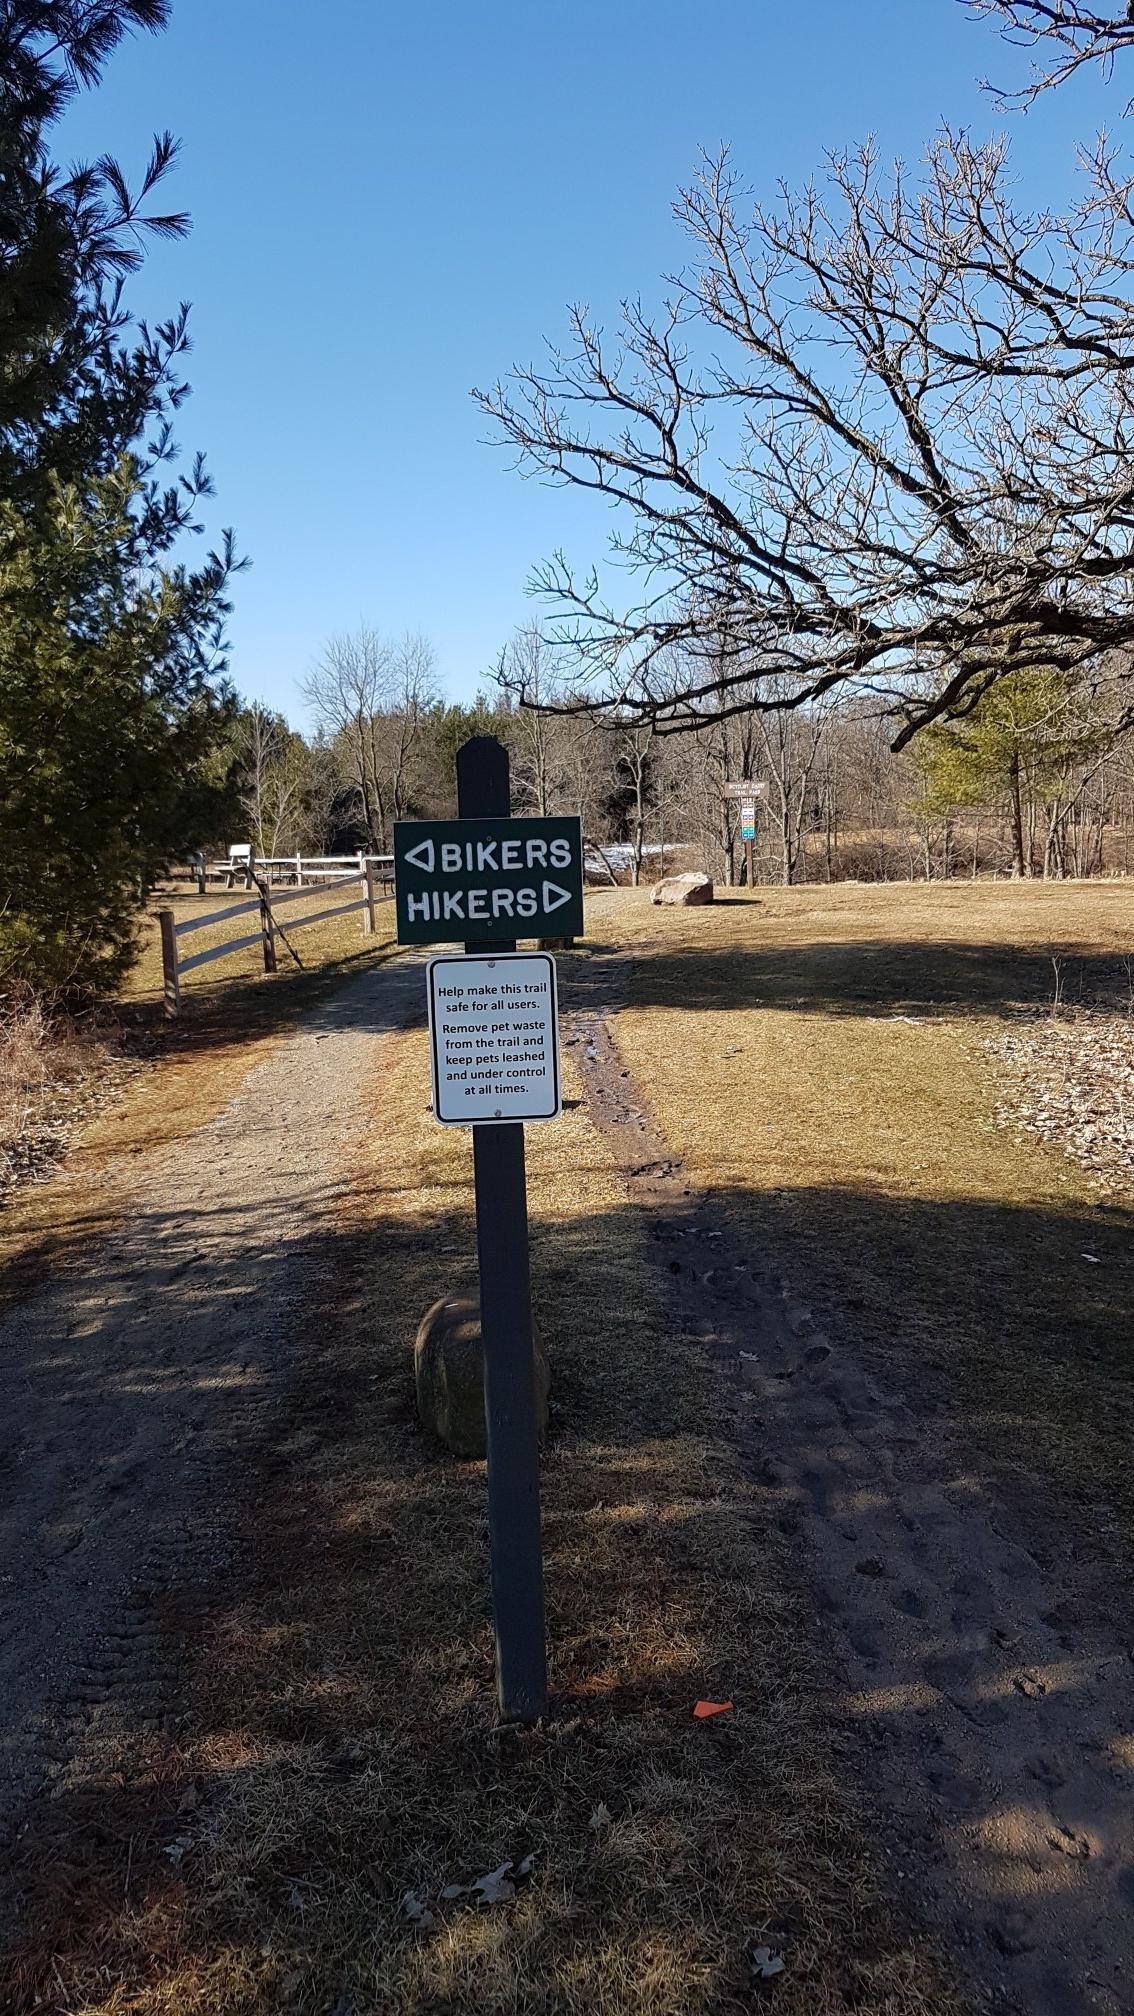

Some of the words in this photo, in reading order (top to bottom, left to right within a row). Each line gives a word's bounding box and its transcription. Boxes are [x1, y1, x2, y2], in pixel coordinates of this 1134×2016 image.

[441, 838, 572, 873] BIKERS
[407, 888, 538, 922] HIKERS
[438, 986, 464, 998] Help
[467, 985, 498, 996] make
[501, 984, 522, 994] this
[524, 983, 547, 993] trail
[446, 1002, 469, 1012] safe
[472, 1001, 488, 1011] for
[491, 1000, 504, 1010] all
[507, 1000, 540, 1009] users.
[442, 1024, 488, 1033] Remove
[491, 1023, 510, 1033] pet
[512, 1021, 546, 1031] waste
[445, 1039, 472, 1049] from
[476, 1038, 495, 1048] the
[497, 1037, 520, 1047] trail
[523, 1035, 544, 1045] and
[445, 1055, 473, 1066] keep
[476, 1054, 500, 1066] pets
[502, 1051, 545, 1062] leashed
[446, 1070, 467, 1080] and
[470, 1068, 504, 1079] under
[506, 1067, 546, 1078] control
[464, 1086, 476, 1095] at
[478, 1084, 492, 1095] all
[494, 1084, 529, 1094] times.
